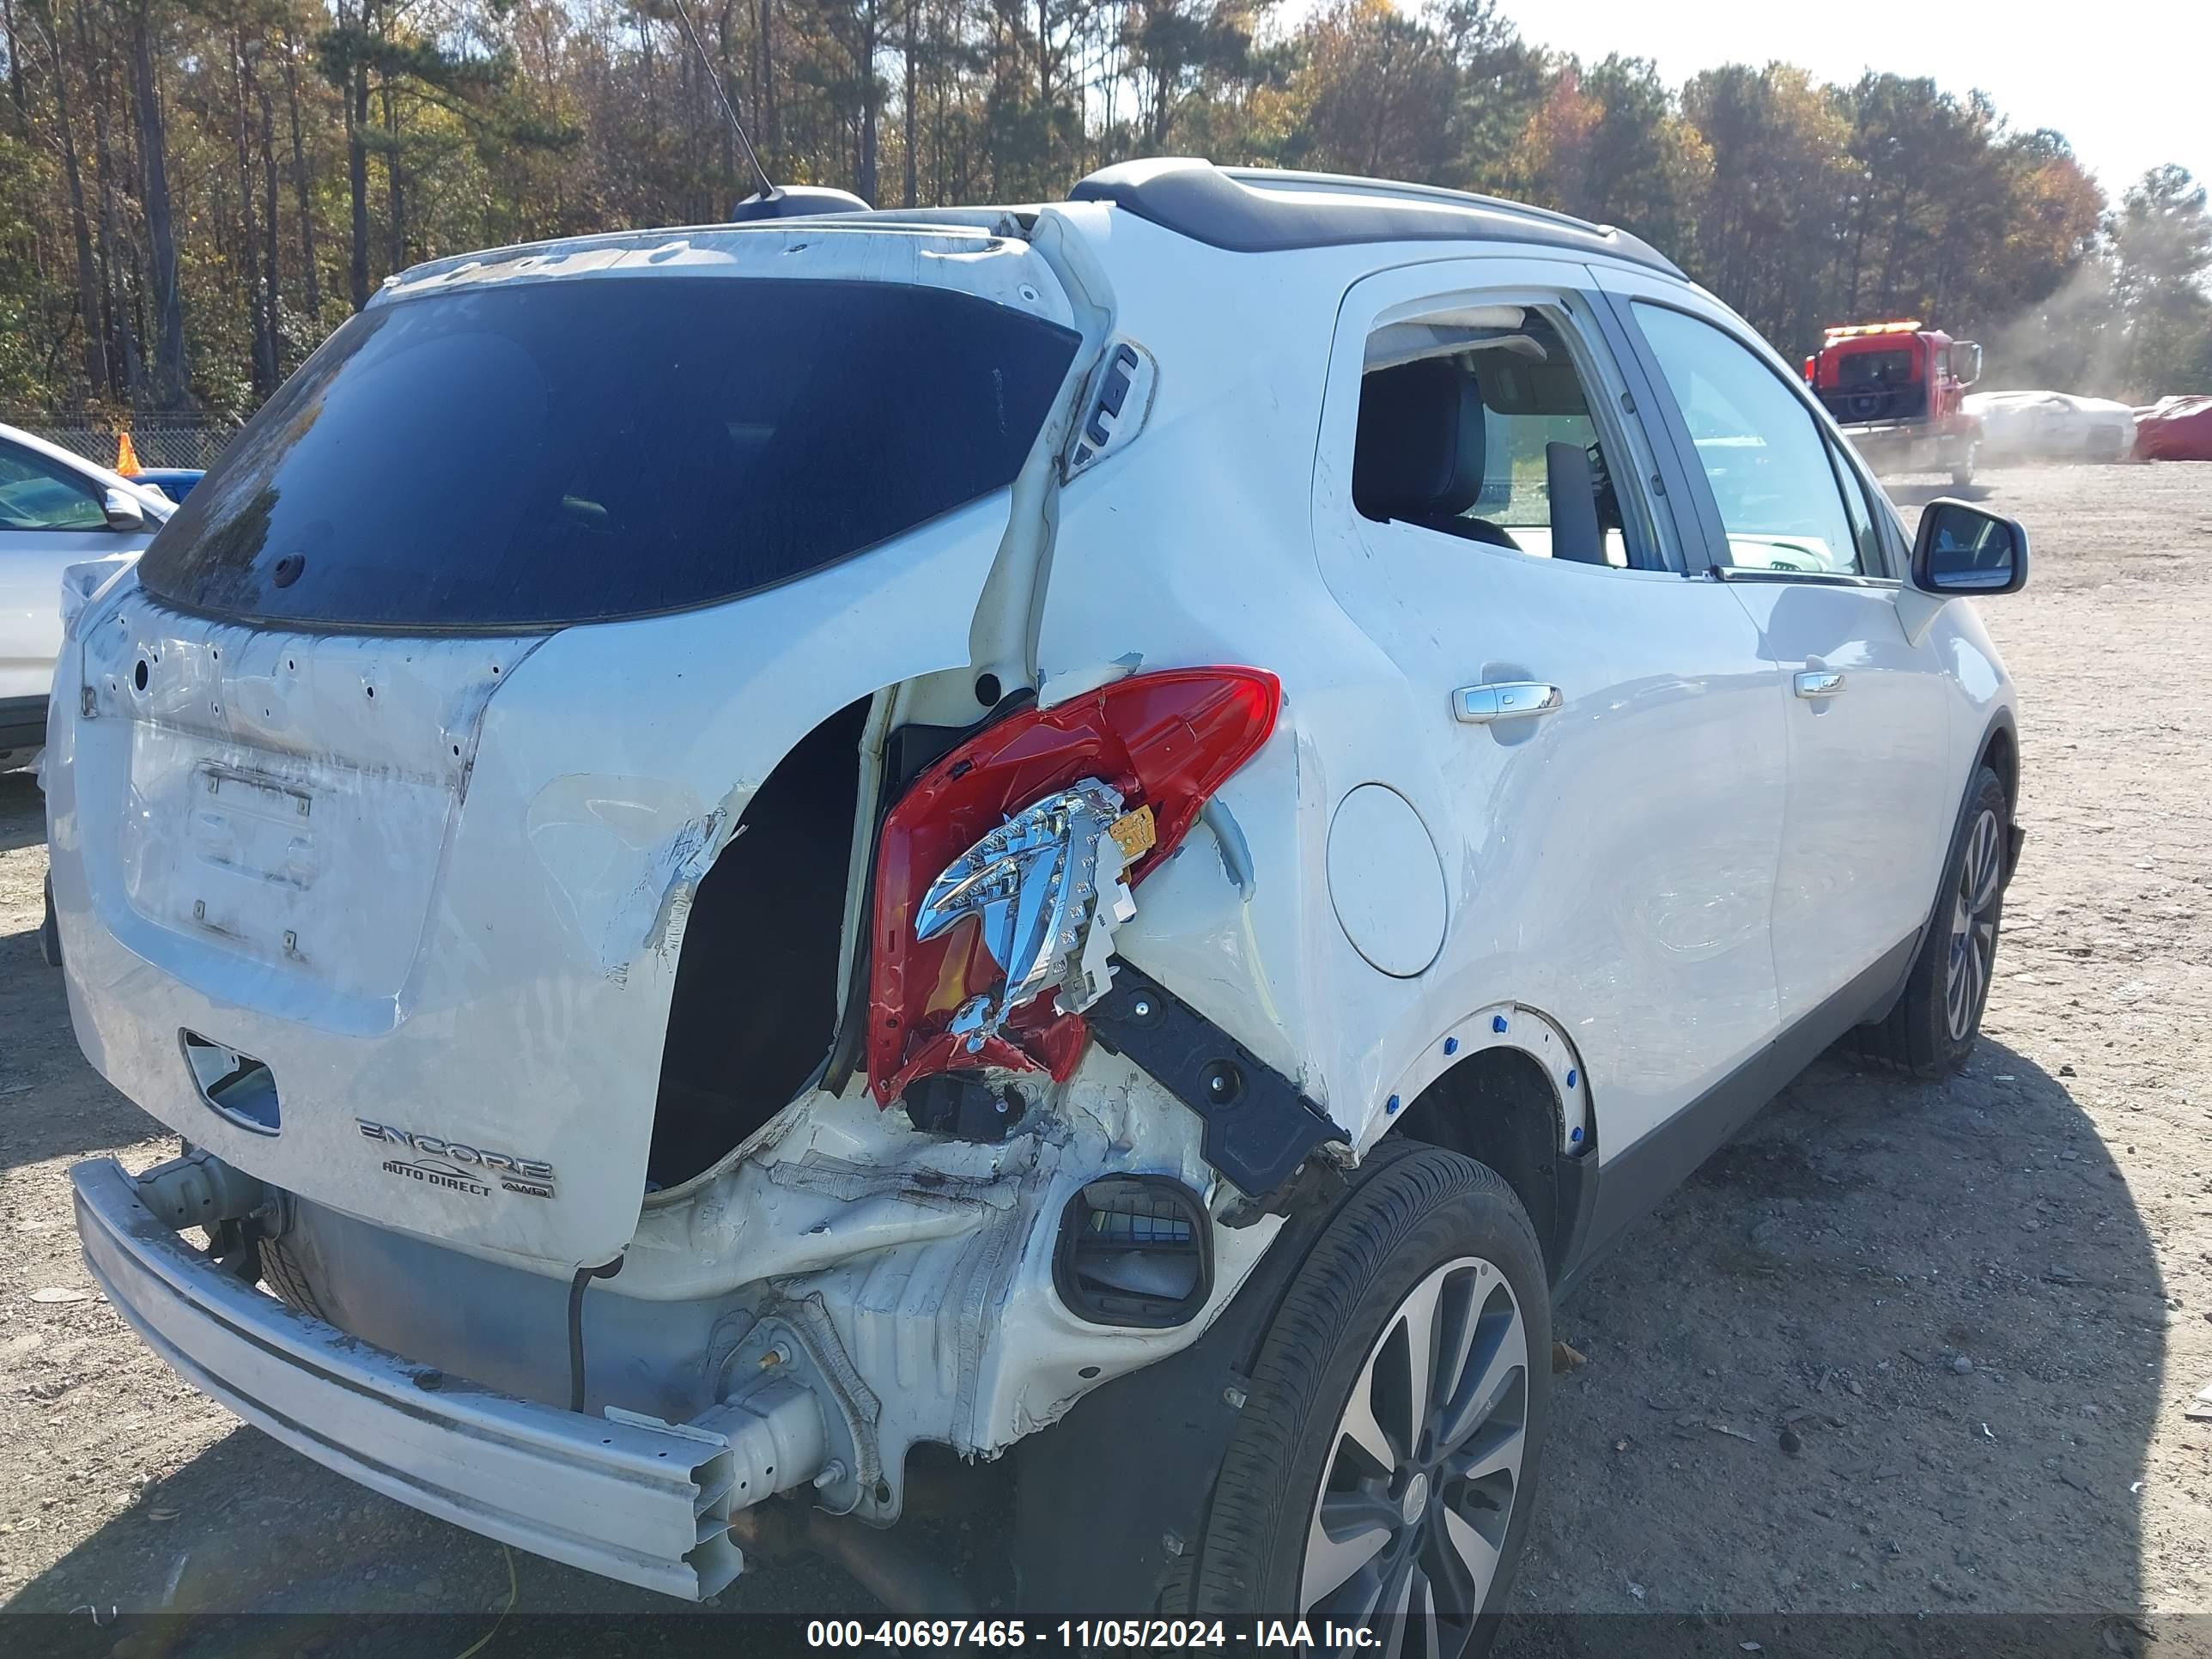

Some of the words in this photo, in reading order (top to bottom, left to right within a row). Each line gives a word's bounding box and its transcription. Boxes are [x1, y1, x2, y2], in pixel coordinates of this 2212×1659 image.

[355, 1117, 556, 1182] ENCORE
[382, 1161, 423, 1180] AUTO
[428, 1174, 492, 1197] DIRECT
[502, 1181, 550, 1198] AWD
